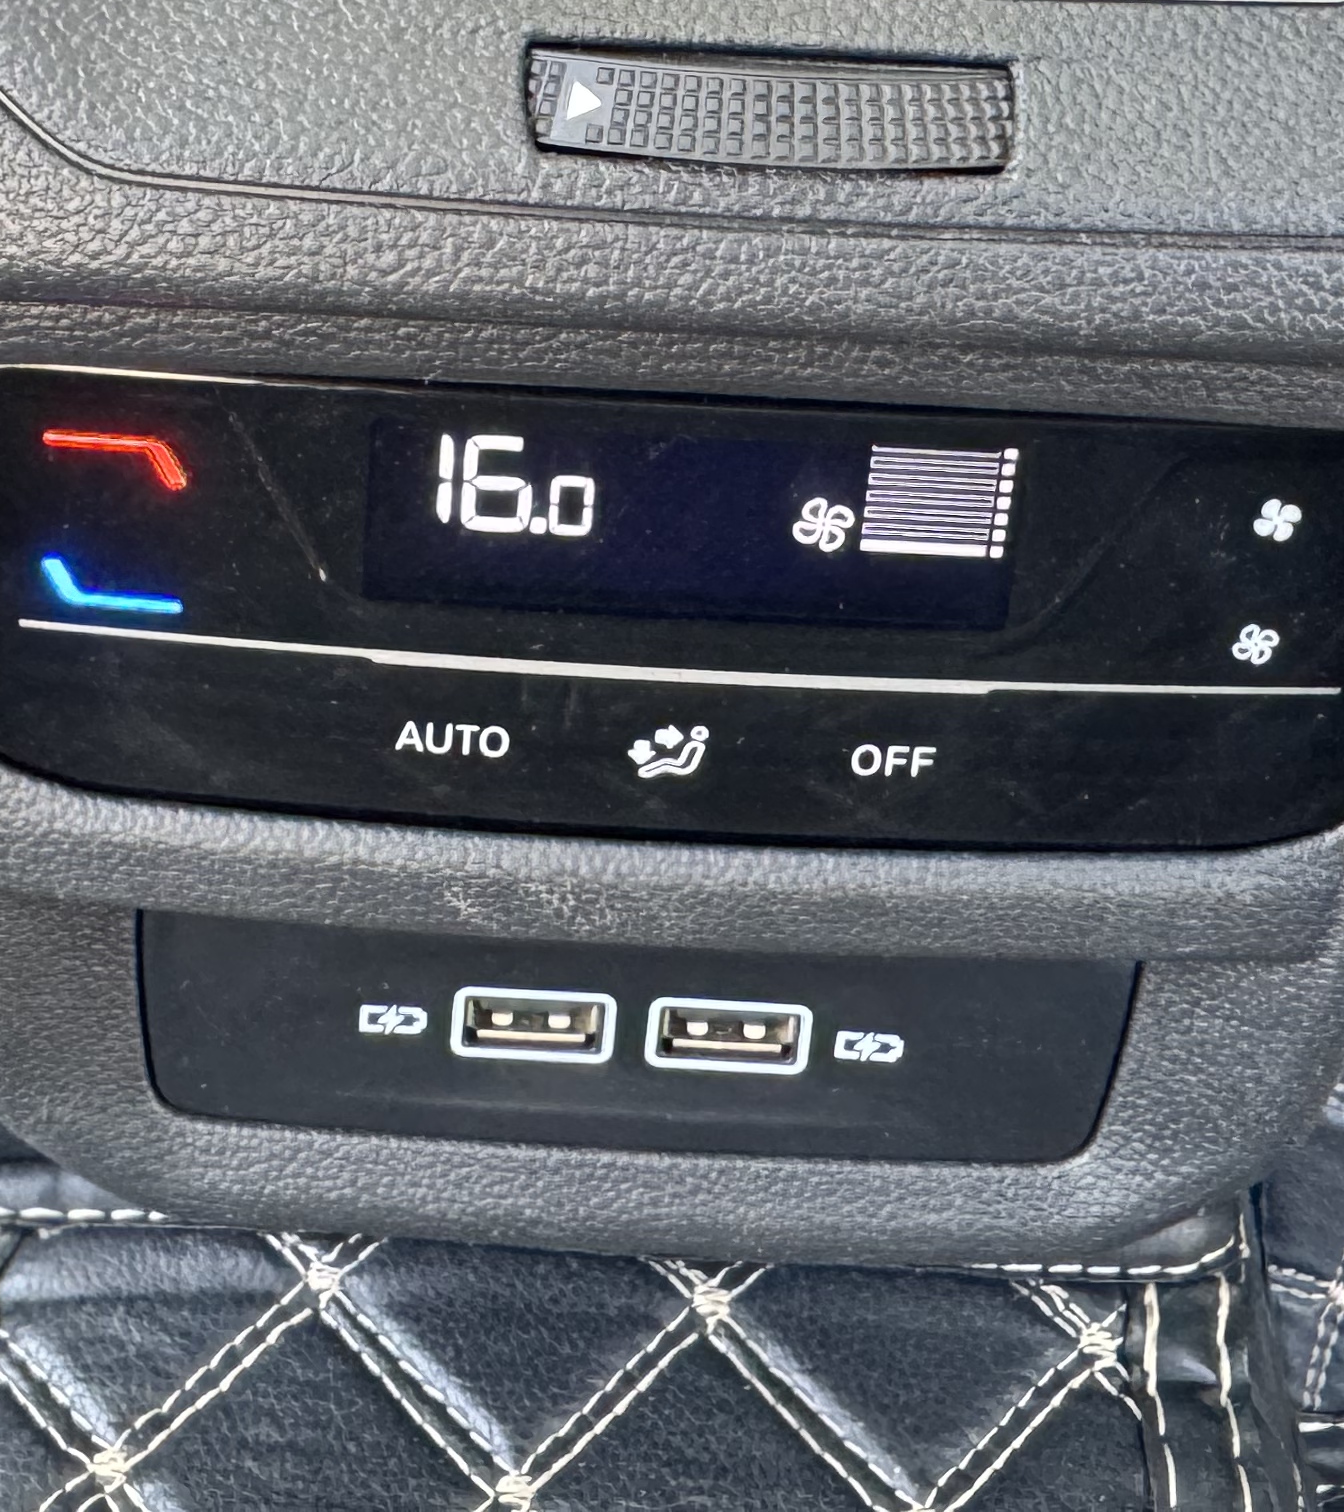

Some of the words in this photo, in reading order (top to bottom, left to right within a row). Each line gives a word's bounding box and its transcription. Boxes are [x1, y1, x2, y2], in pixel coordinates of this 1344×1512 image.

[435, 432, 597, 538] 16.0
[393, 719, 512, 760] AUTO
[849, 742, 938, 779] OFF
